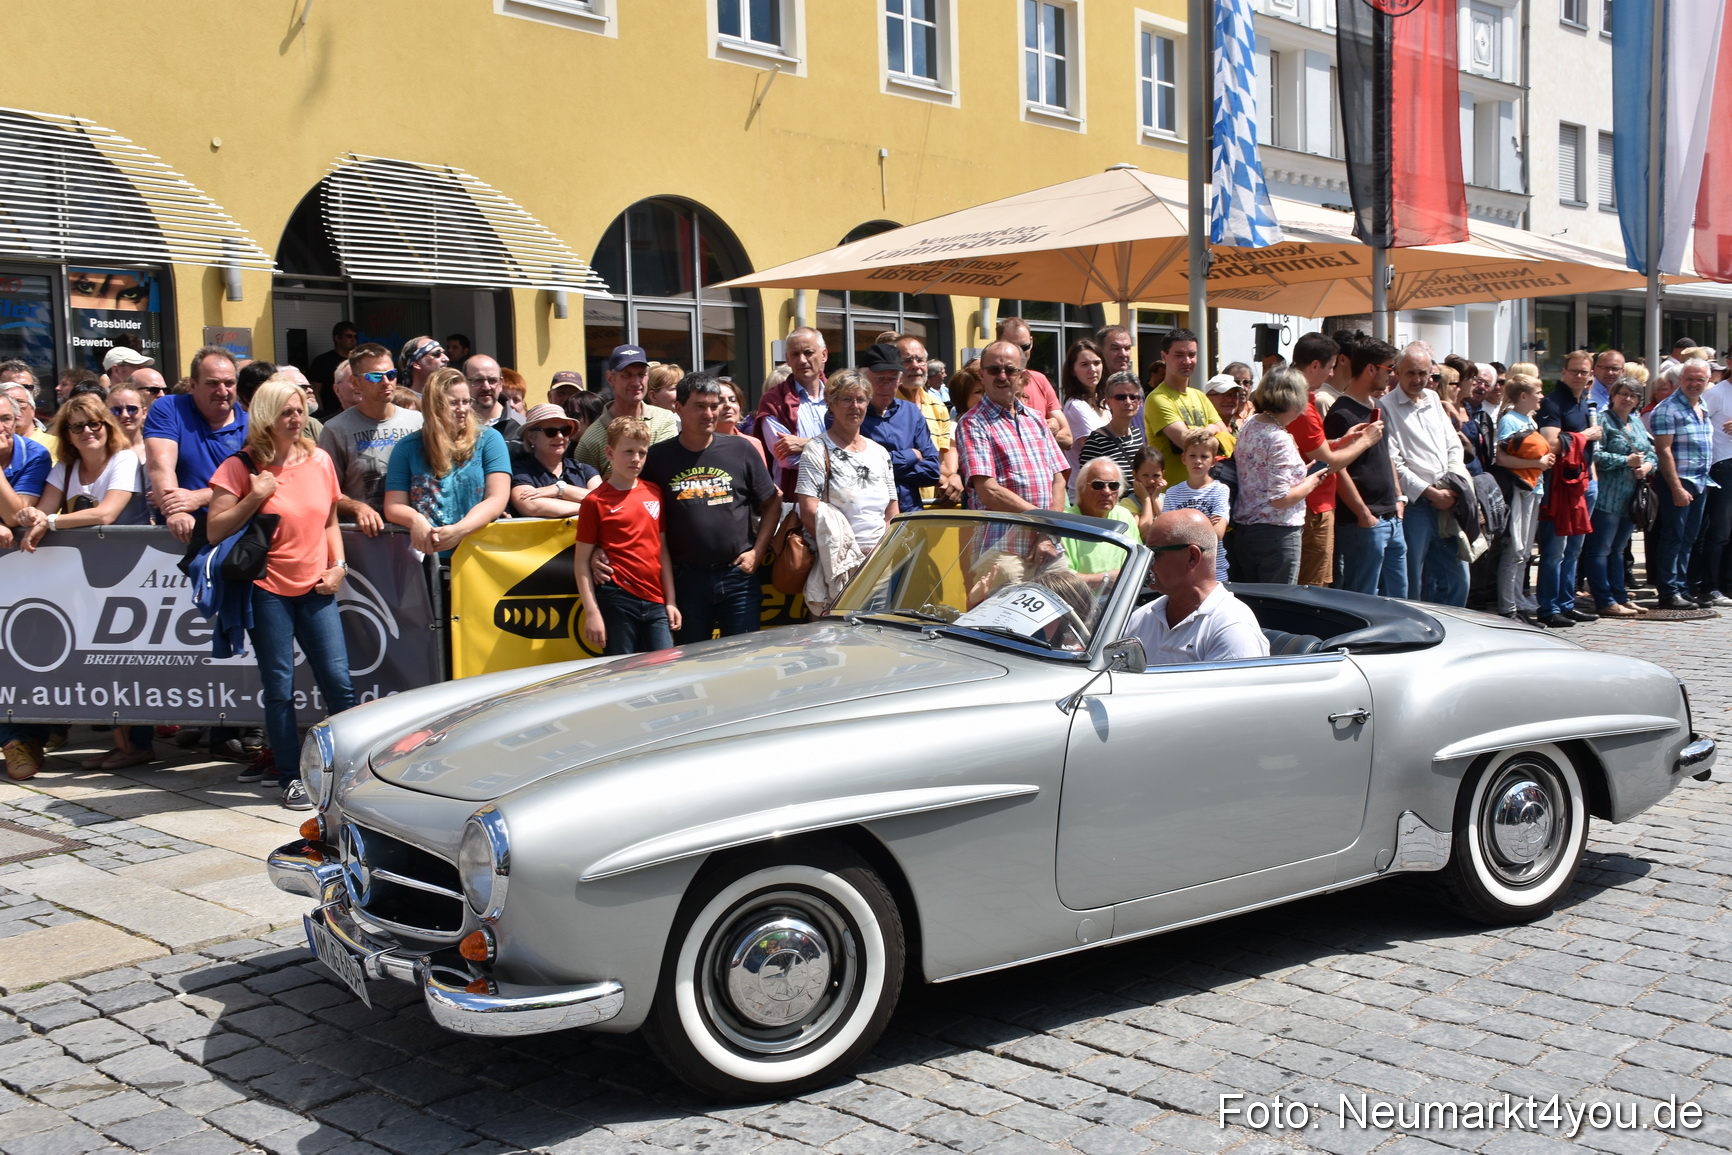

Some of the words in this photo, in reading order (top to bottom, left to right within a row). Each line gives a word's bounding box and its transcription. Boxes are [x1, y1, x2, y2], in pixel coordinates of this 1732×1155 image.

[910, 225, 1048, 247] Neumarkter
[861, 233, 1051, 262] Lammsbräu
[0, 299, 40, 318] ler
[90, 318, 141, 330] Passbilder
[354, 429, 389, 442] UNCLE
[669, 467, 705, 487] AMAZON
[707, 467, 733, 482] RIVER
[139, 569, 189, 588] Aut
[1011, 593, 1045, 613] 249
[92, 597, 216, 646] Die
[84, 654, 198, 666] BREITENBRUNN
